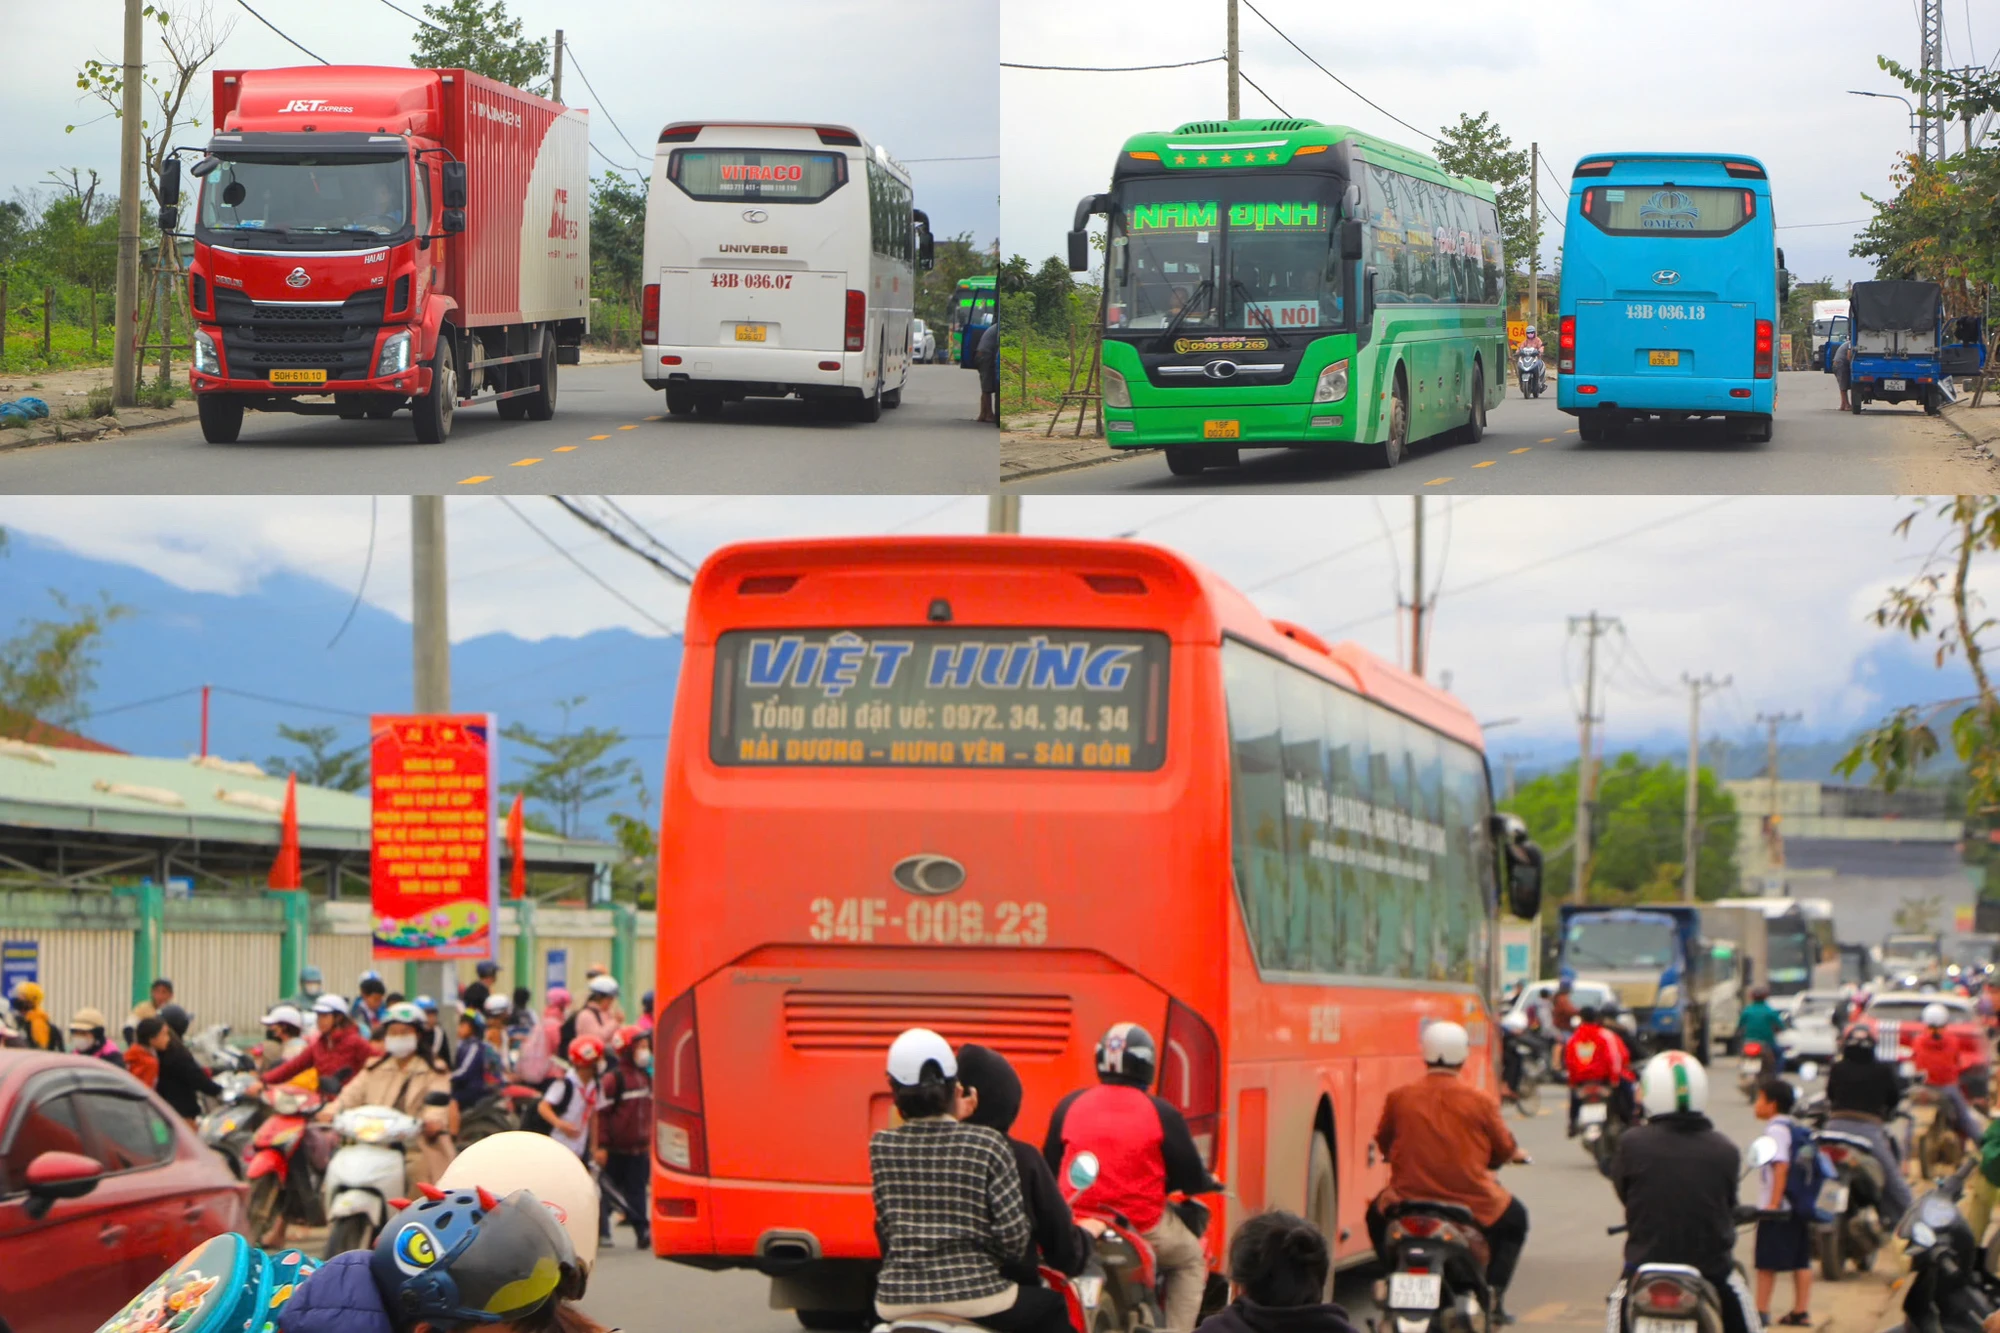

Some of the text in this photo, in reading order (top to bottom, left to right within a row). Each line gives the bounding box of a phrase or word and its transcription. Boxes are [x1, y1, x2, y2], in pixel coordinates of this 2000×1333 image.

[278, 99, 354, 113] J&T EXPRESS
[720, 164, 804, 182] VITRACO
[1133, 201, 1318, 231] NAM ĐỊNH
[1643, 218, 1695, 229] OMEGA
[719, 244, 789, 254] UNIVERSE
[1247, 304, 1316, 328] HÀ NỘI
[1190, 341, 1219, 350] 0905
[1221, 341, 1243, 349] 689
[1245, 340, 1266, 349] 265
[745, 630, 1144, 697] VIỆT HƯNG
[752, 694, 1130, 735] Tổng đài đặt vé: 0972. 34. 34. 34
[740, 732, 779, 761] HẢI
[785, 738, 865, 762] DƯƠNG
[891, 739, 955, 764] HƯNG
[961, 737, 1006, 764] YÊN
[1033, 738, 1075, 765] SÀI
[1081, 739, 1132, 766] GÒN
[808, 896, 1048, 946] 34F-008.23
